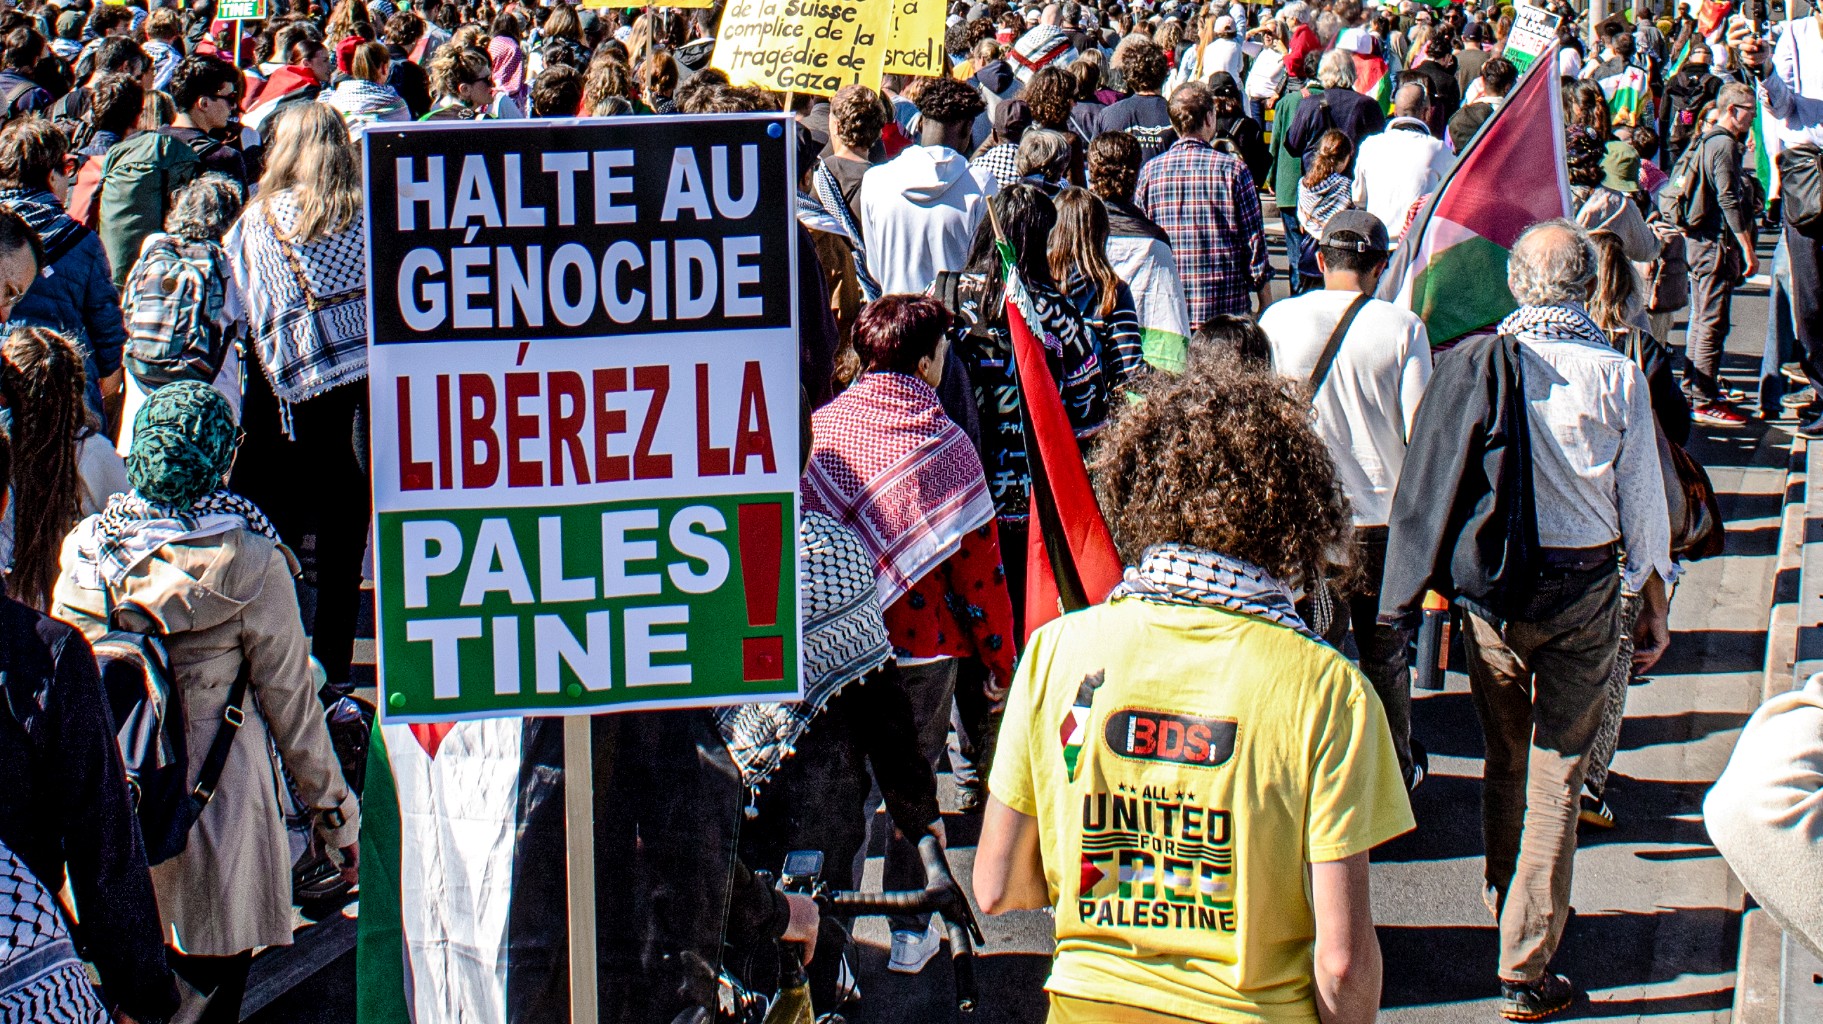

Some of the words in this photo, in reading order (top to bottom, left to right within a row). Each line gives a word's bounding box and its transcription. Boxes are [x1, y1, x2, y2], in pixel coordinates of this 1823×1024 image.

[221, 3, 253, 16] TINE
[758, 0, 777, 18] la
[723, 16, 804, 47] complice
[814, 20, 843, 40] de
[854, 24, 875, 46] la
[731, 37, 828, 77] tragédie
[837, 47, 866, 70] de
[777, 66, 841, 91] Gaza
[396, 149, 638, 232] HALTE
[661, 144, 759, 221] AU
[399, 226, 764, 332] GÉNOCIDE
[396, 342, 673, 493] LIBÉREZ
[695, 361, 778, 478] LA
[401, 505, 731, 608] PALES
[406, 605, 693, 700] TINE
[1142, 784, 1170, 800] ALL
[1083, 792, 1232, 846] UNITED
[1141, 834, 1176, 856] FOR
[1080, 849, 1234, 910] FREE
[1079, 898, 1237, 936] PALESTINE
